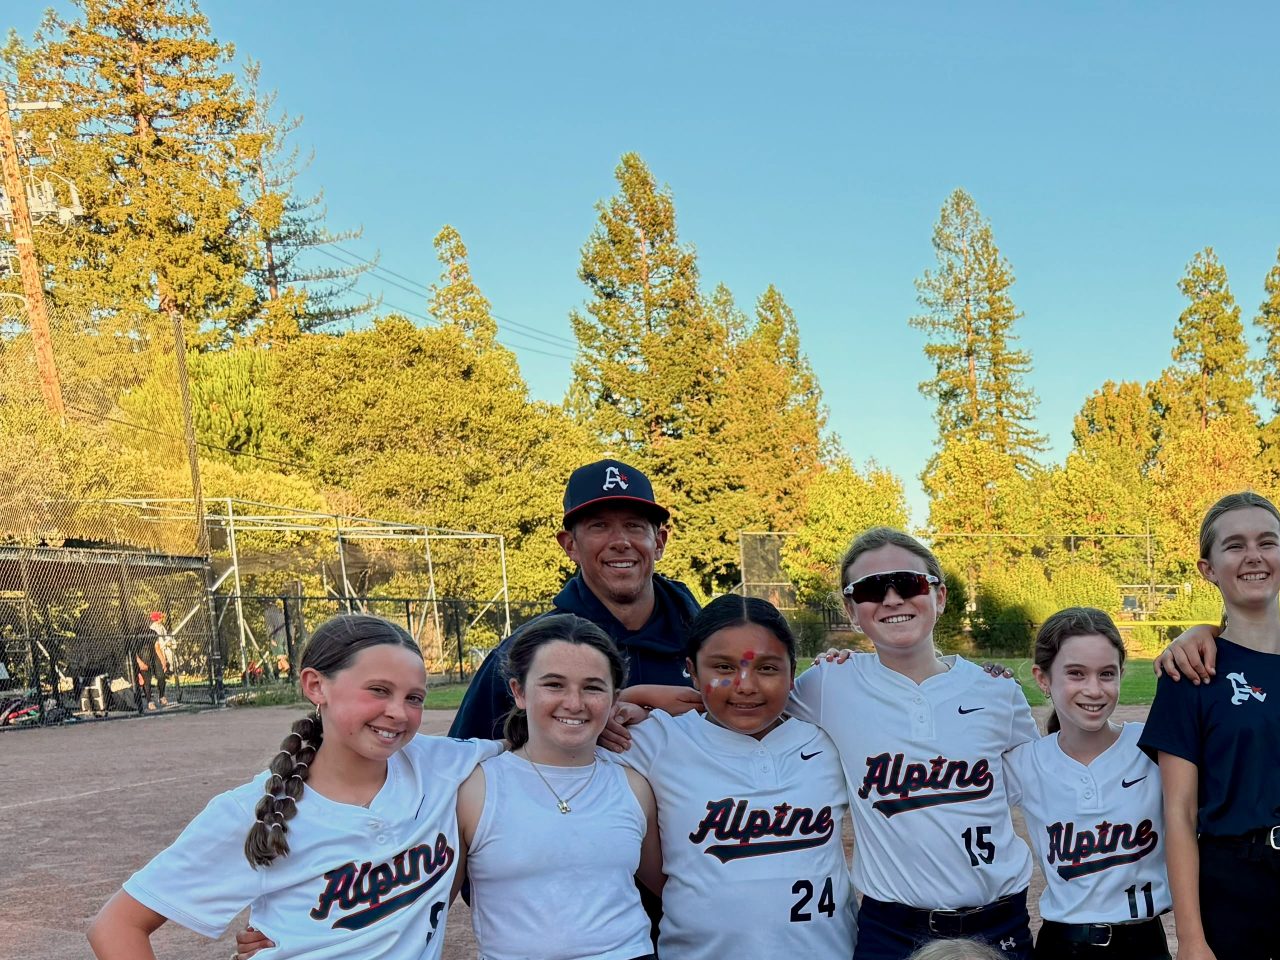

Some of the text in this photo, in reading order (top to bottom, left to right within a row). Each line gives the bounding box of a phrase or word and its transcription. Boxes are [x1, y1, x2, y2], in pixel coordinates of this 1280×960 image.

[603, 467, 628, 490] A
[858, 752, 994, 800] Alpine
[688, 798, 834, 846] Alpine
[1046, 819, 1158, 867] Alpine
[961, 826, 996, 867] 15
[310, 832, 455, 921] Alpine
[790, 877, 836, 922] 24
[1124, 882, 1155, 918] 11
